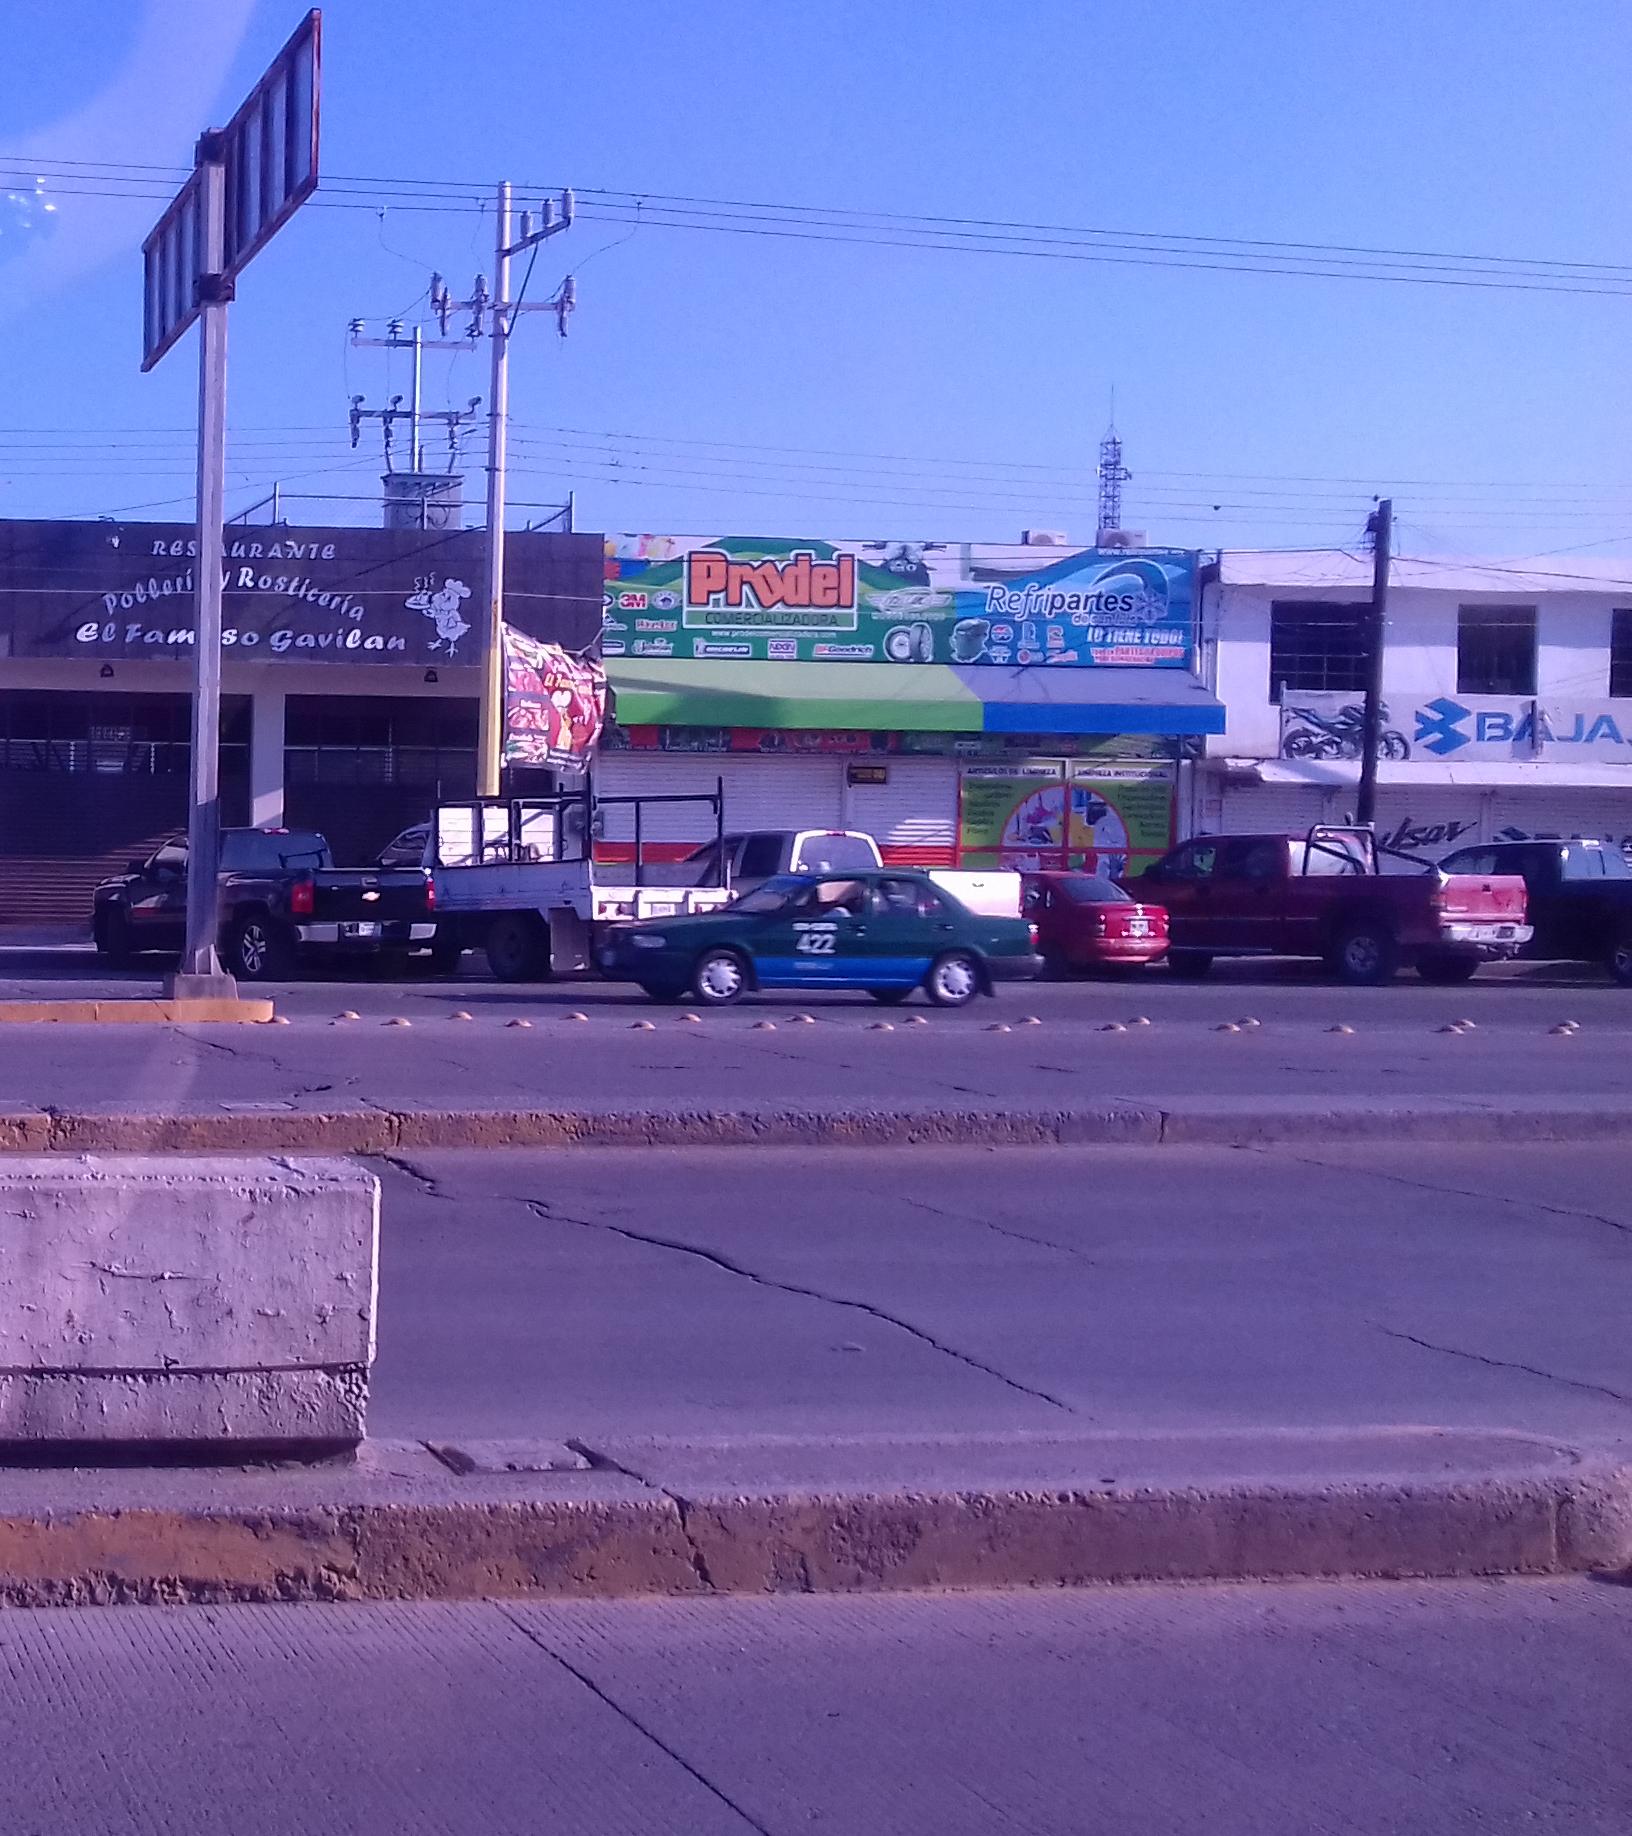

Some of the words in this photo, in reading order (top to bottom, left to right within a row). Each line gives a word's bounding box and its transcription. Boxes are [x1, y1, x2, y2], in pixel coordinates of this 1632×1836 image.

[151, 540, 336, 560] RESURANTE
[103, 568, 196, 616] Pollerí
[689, 550, 855, 609] Prodel
[620, 593, 646, 608] 3M
[985, 583, 1135, 619] Refripartes
[76, 622, 116, 644] El
[124, 623, 261, 647] Famso
[269, 628, 407, 653] Gavilan
[1477, 711, 1632, 745] BAJA
[796, 932, 837, 954] 422
